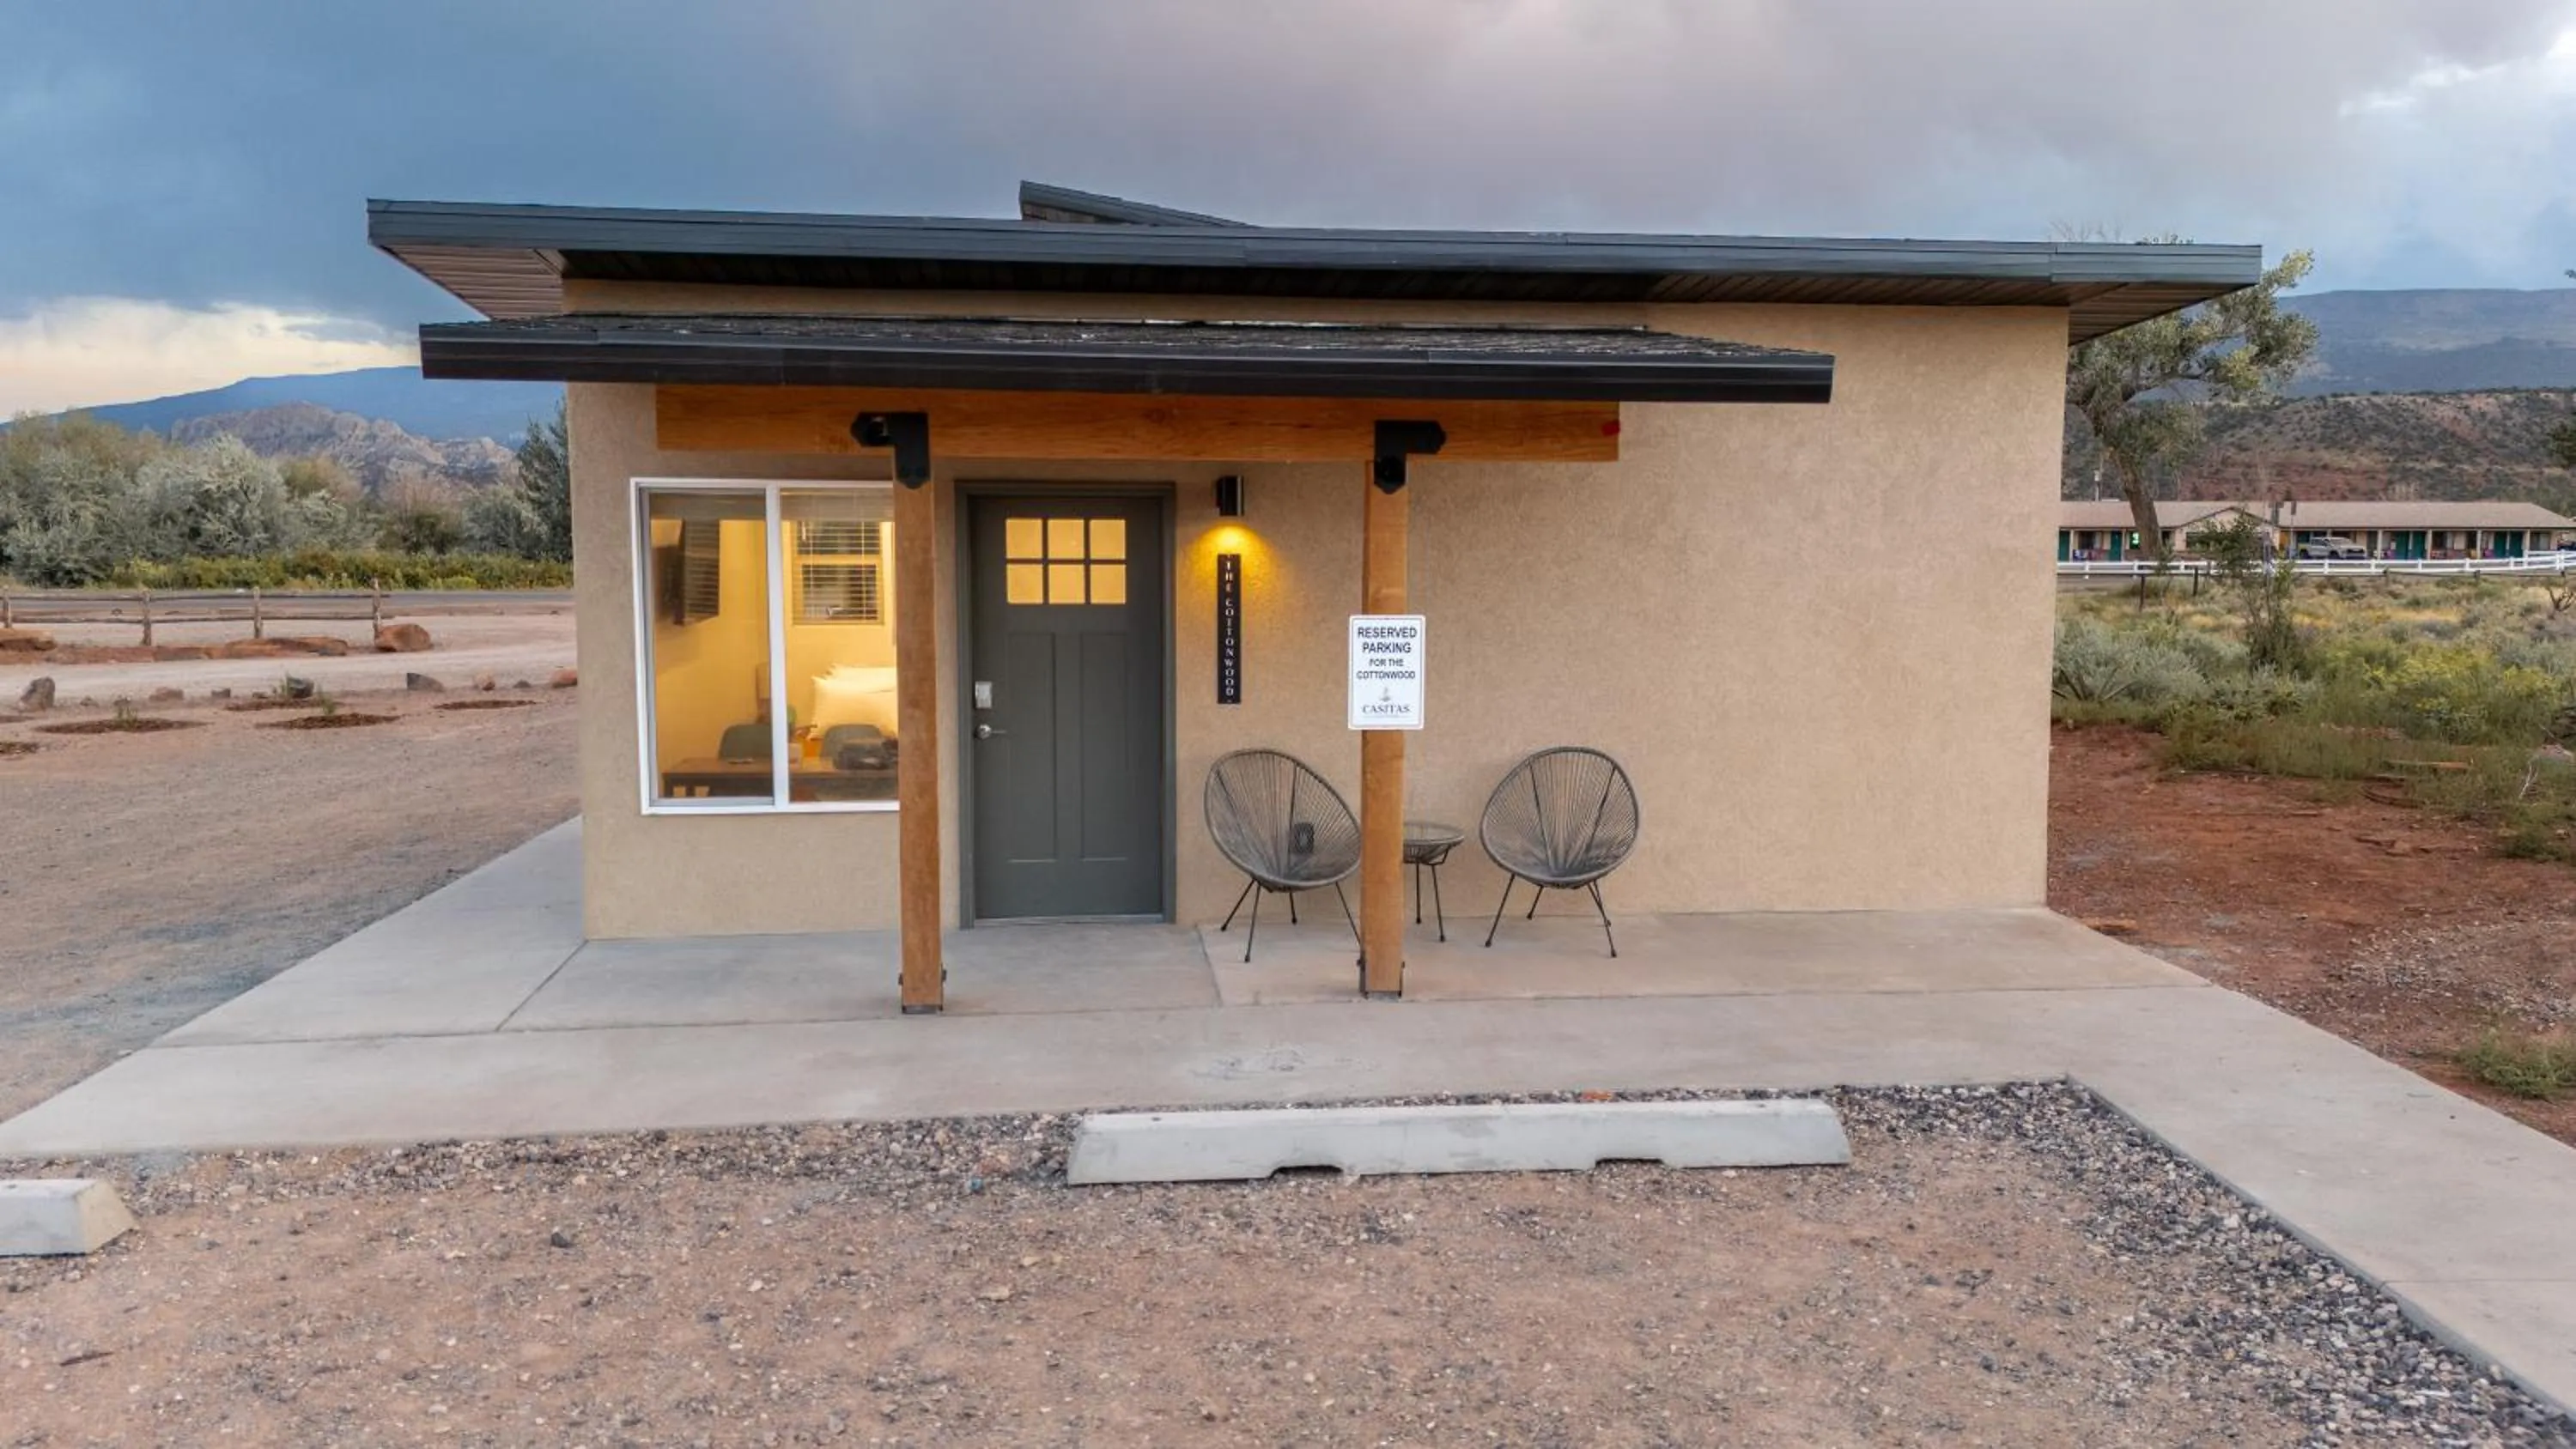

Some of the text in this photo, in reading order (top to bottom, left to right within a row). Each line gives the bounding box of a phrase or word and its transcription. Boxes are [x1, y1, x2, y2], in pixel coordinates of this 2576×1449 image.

[1358, 627, 1418, 638] RESERVED
[1224, 597, 1235, 696] COTTONWOOD
[1362, 642, 1412, 653] PARKING
[1357, 670, 1416, 679] COTTONWOOD
[1362, 704, 1411, 713] CASITAS
